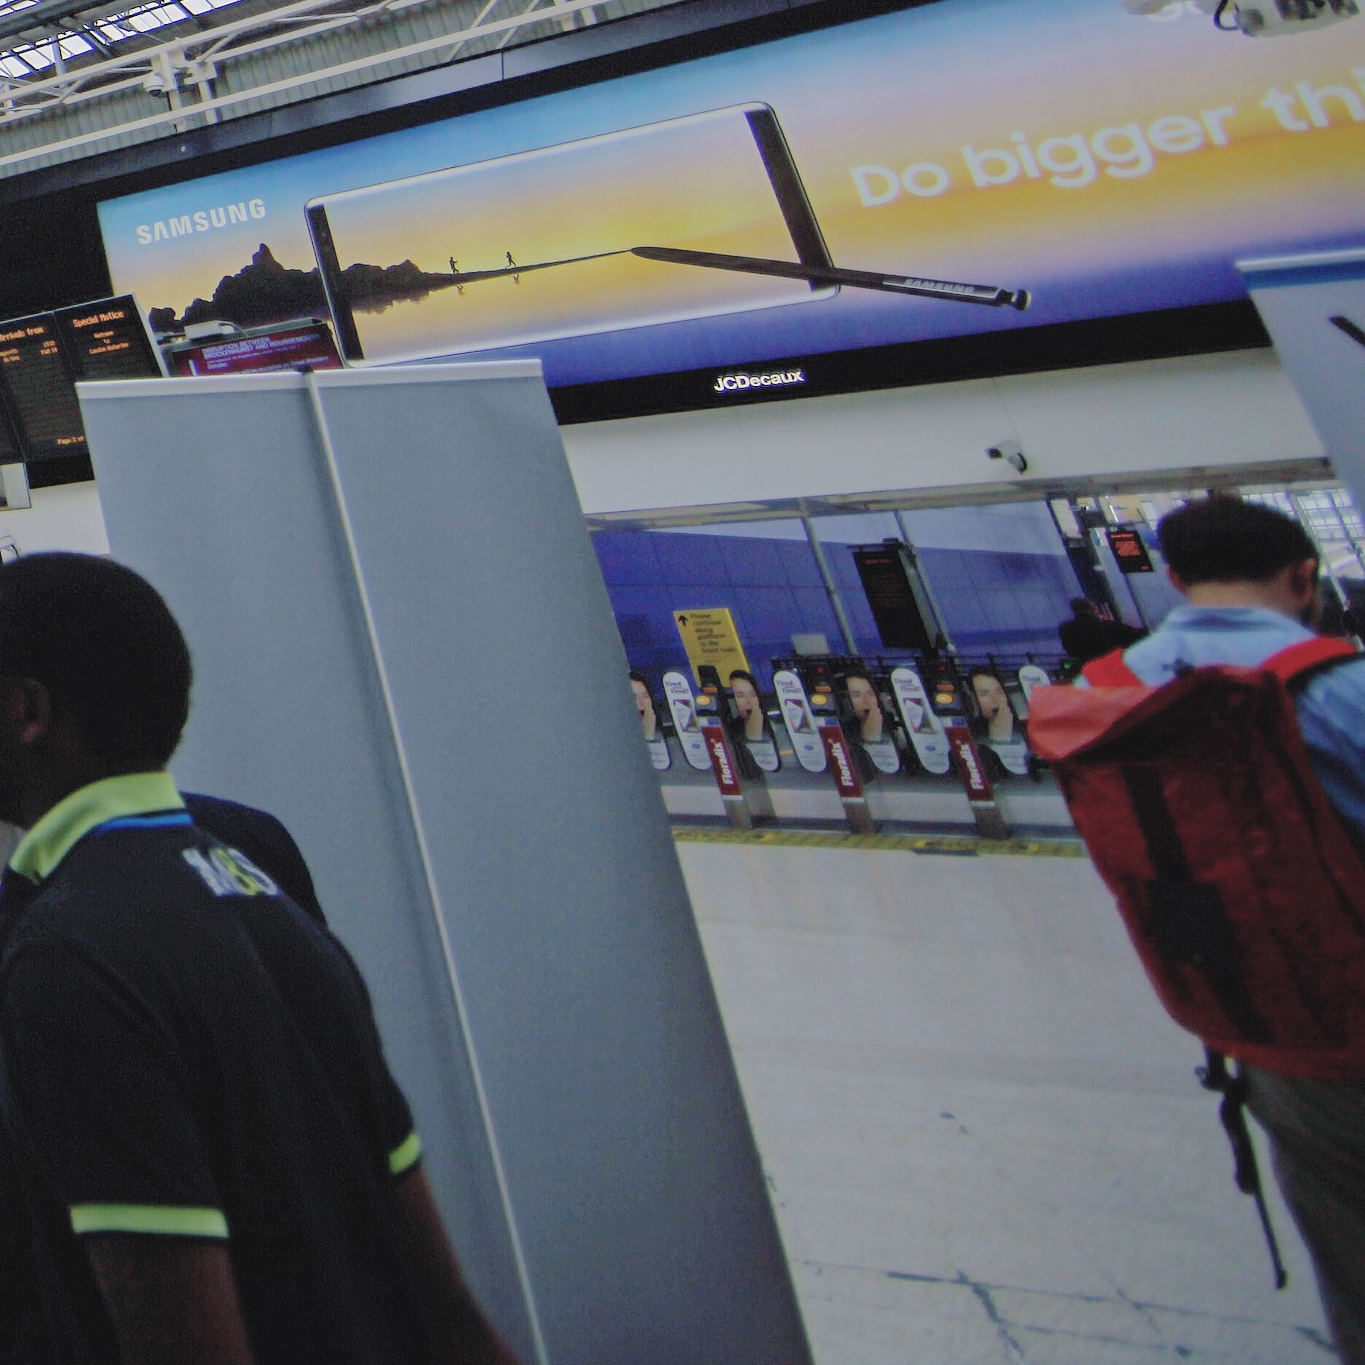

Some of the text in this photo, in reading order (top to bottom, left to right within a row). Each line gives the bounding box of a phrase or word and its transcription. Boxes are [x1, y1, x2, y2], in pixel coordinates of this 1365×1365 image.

[849, 159, 951, 208] Do
[959, 102, 1238, 190] bigger
[135, 198, 266, 245] SAMSUNG
[904, 276, 976, 296] SAMSUNG
[72, 310, 125, 328] Special Notice
[714, 367, 805, 393] JCDecaux
[713, 741, 734, 785] Floradix
[830, 741, 854, 786] Floradix
[960, 743, 984, 790] Floradix
